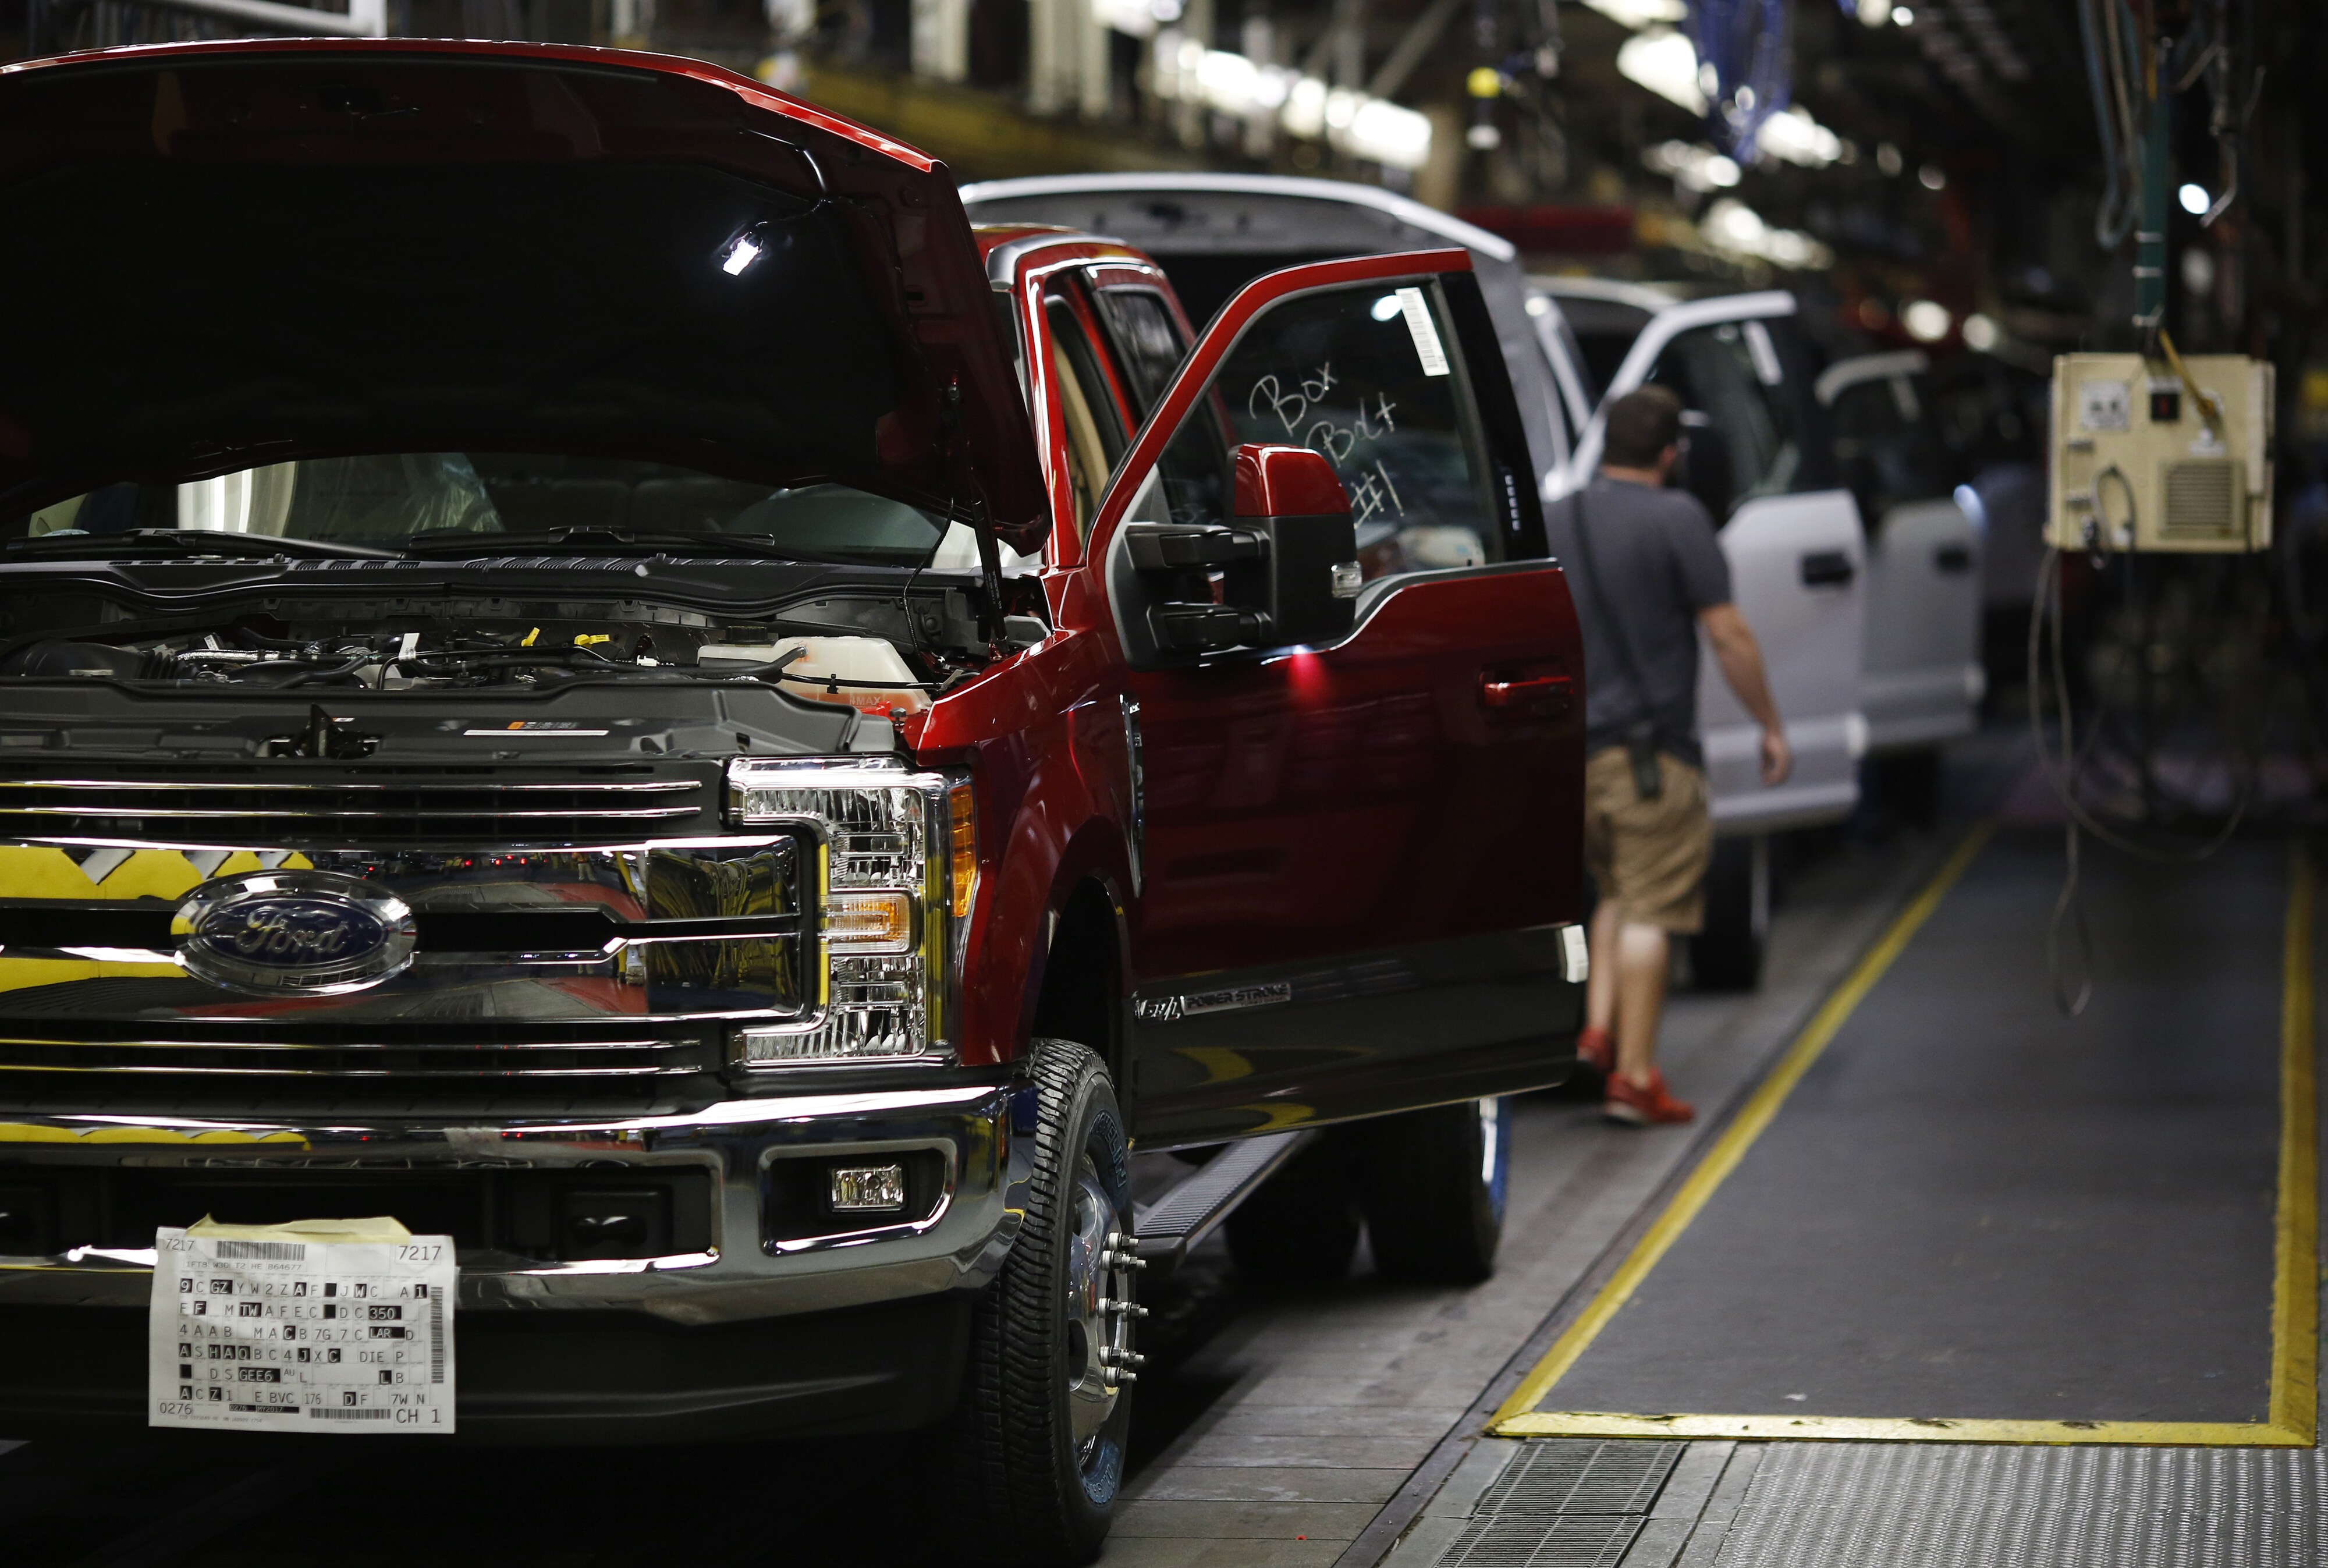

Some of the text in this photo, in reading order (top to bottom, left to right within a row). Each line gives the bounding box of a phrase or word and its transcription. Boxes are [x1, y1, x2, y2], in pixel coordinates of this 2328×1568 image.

[1249, 361, 1337, 437] Box
[1350, 459, 1404, 529] #1
[235, 907, 349, 954] Ford
[165, 1239, 195, 1251] 7217
[398, 1246, 441, 1261] 7217
[181, 1280, 189, 1292] 9
[400, 1286, 408, 1298] A
[416, 1287, 423, 1299] 1
[370, 1308, 395, 1320] 350
[370, 1328, 391, 1339] LAR
[360, 1351, 384, 1363] DIE
[396, 1351, 404, 1363] P
[239, 1370, 272, 1382] GEE6
[283, 1368, 295, 1377] AU
[300, 1372, 307, 1383] L
[380, 1372, 389, 1385] L
[269, 1392, 294, 1404] BVC
[304, 1393, 321, 1405] 176
[391, 1394, 408, 1406] 7W
[159, 1402, 192, 1415] 0276
[396, 1409, 441, 1424] CH 1
